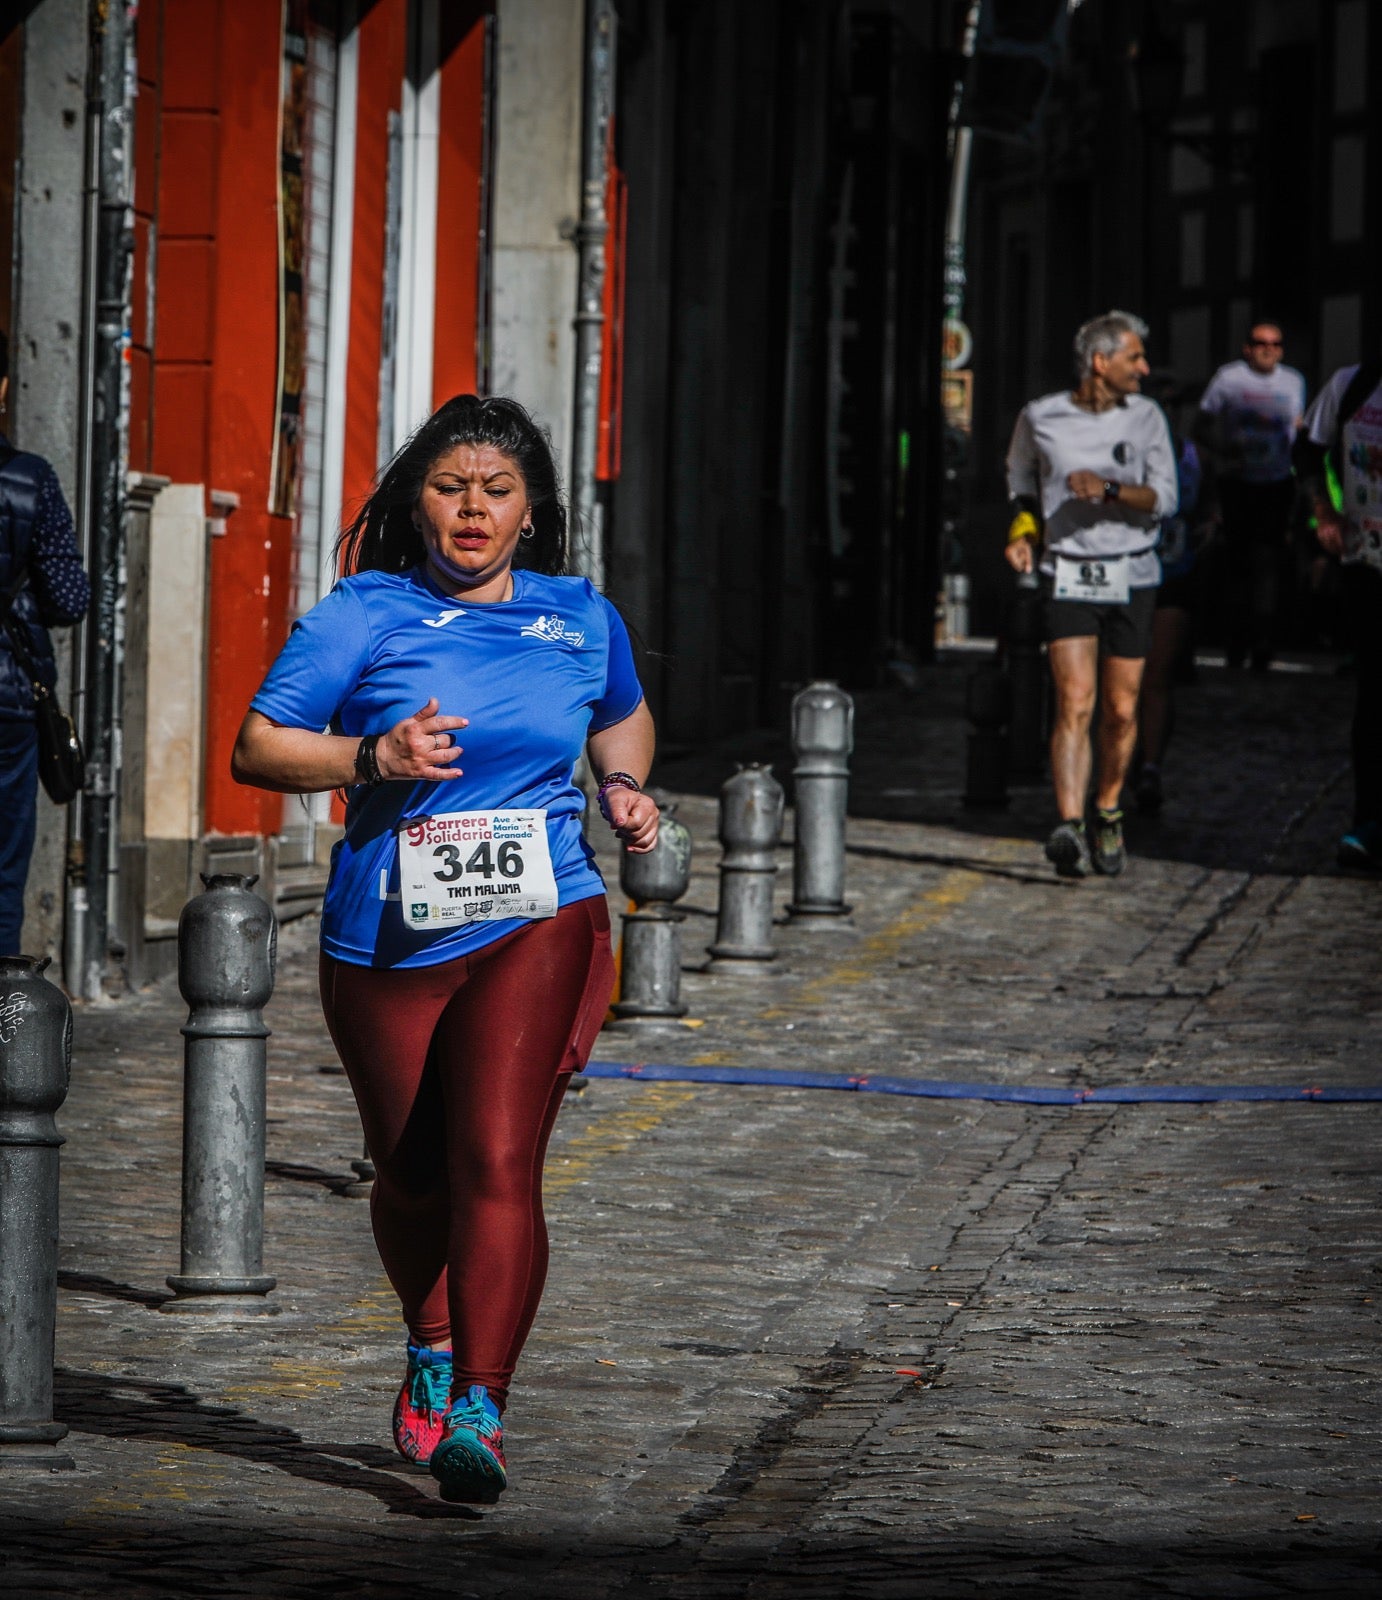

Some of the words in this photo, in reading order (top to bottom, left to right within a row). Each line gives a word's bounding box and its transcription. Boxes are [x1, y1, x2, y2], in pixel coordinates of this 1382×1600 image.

[407, 822, 425, 847] 9
[426, 817, 487, 832] Carrera
[427, 828, 492, 845] Solidaria
[432, 840, 524, 882] 346
[447, 886, 471, 898] TKM
[475, 883, 521, 897] MALUMA
